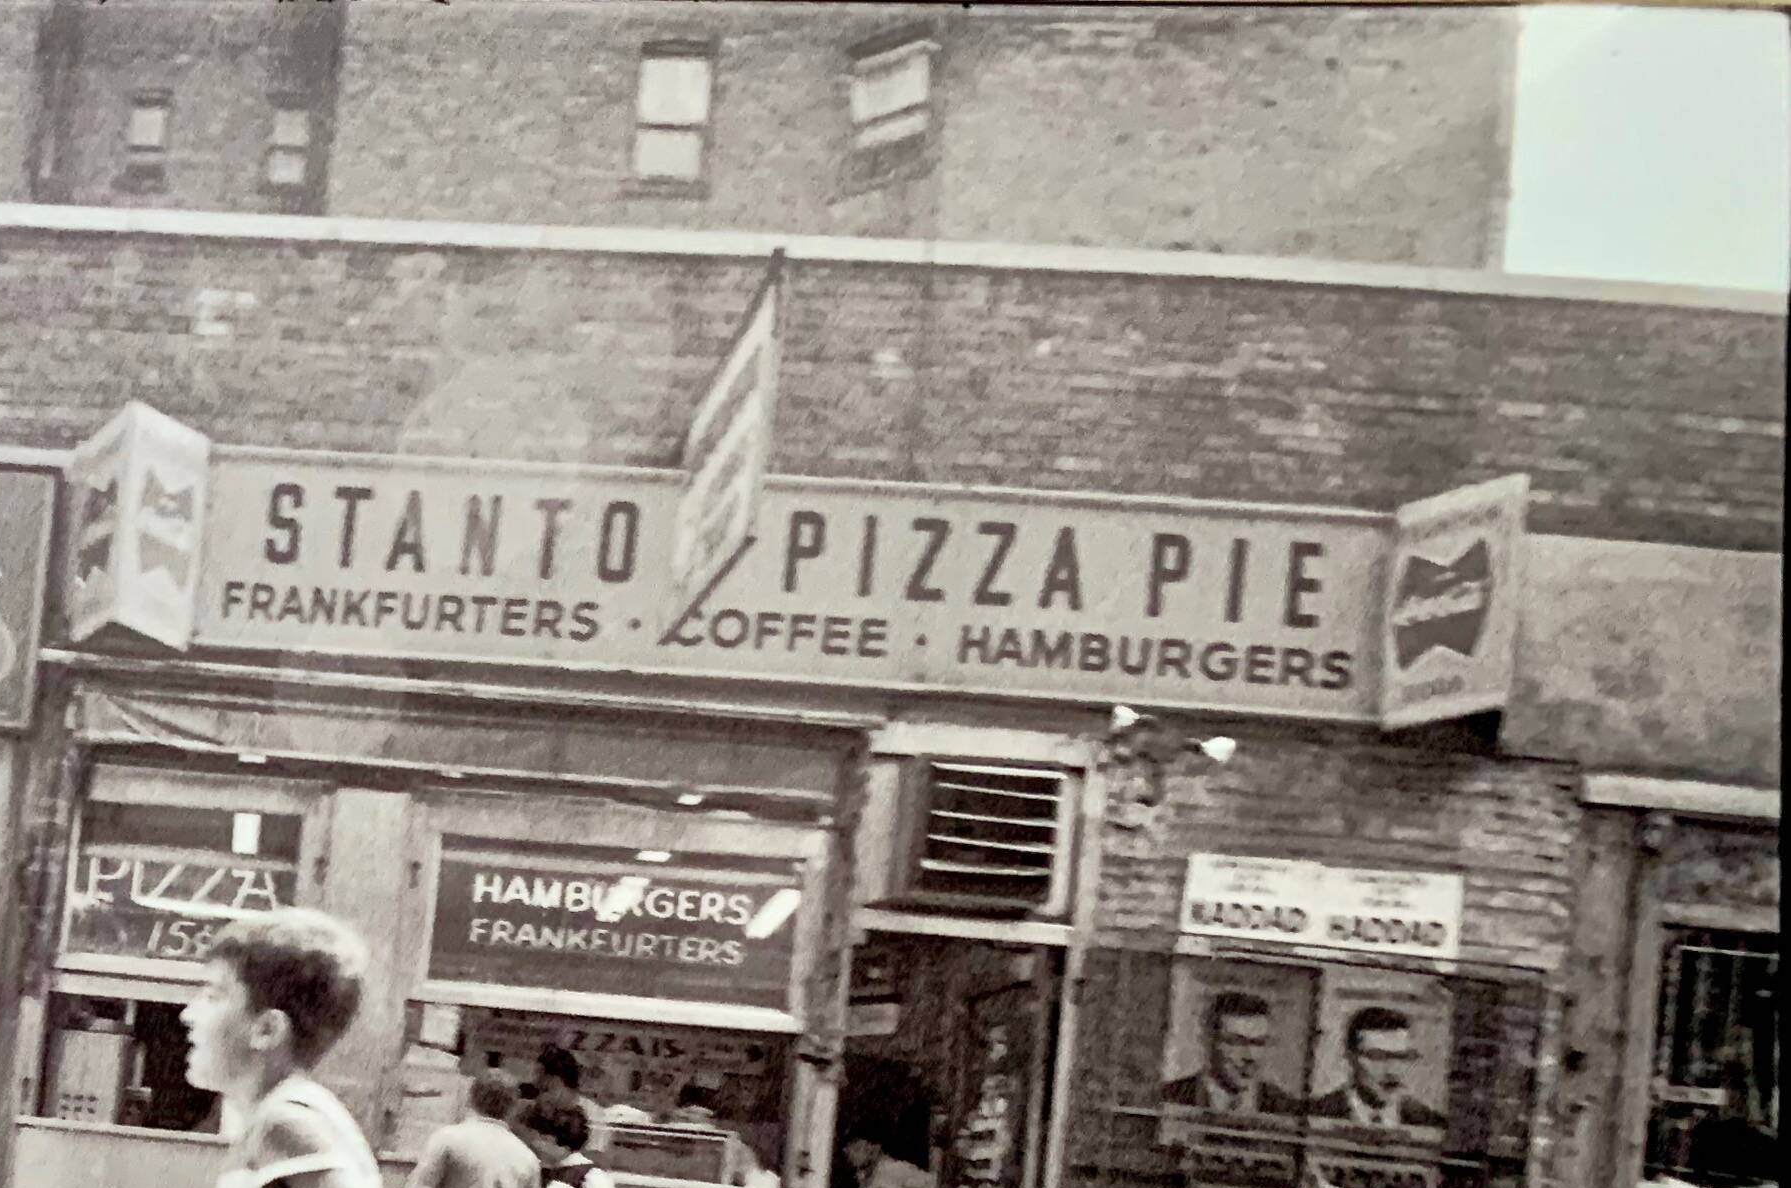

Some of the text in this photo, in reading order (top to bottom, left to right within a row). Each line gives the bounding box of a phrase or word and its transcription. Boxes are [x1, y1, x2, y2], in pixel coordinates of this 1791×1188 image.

[264, 482, 640, 583] STANTO
[783, 510, 1082, 611] PIZZA
[1147, 533, 1328, 629] PIE
[220, 581, 601, 641] FRANKFURTERS
[674, 608, 889, 656] COFFEE
[957, 623, 1353, 690] HAMBURGERS
[84, 856, 278, 911] PIZZA
[467, 918, 746, 966] FRANKFURTERS
